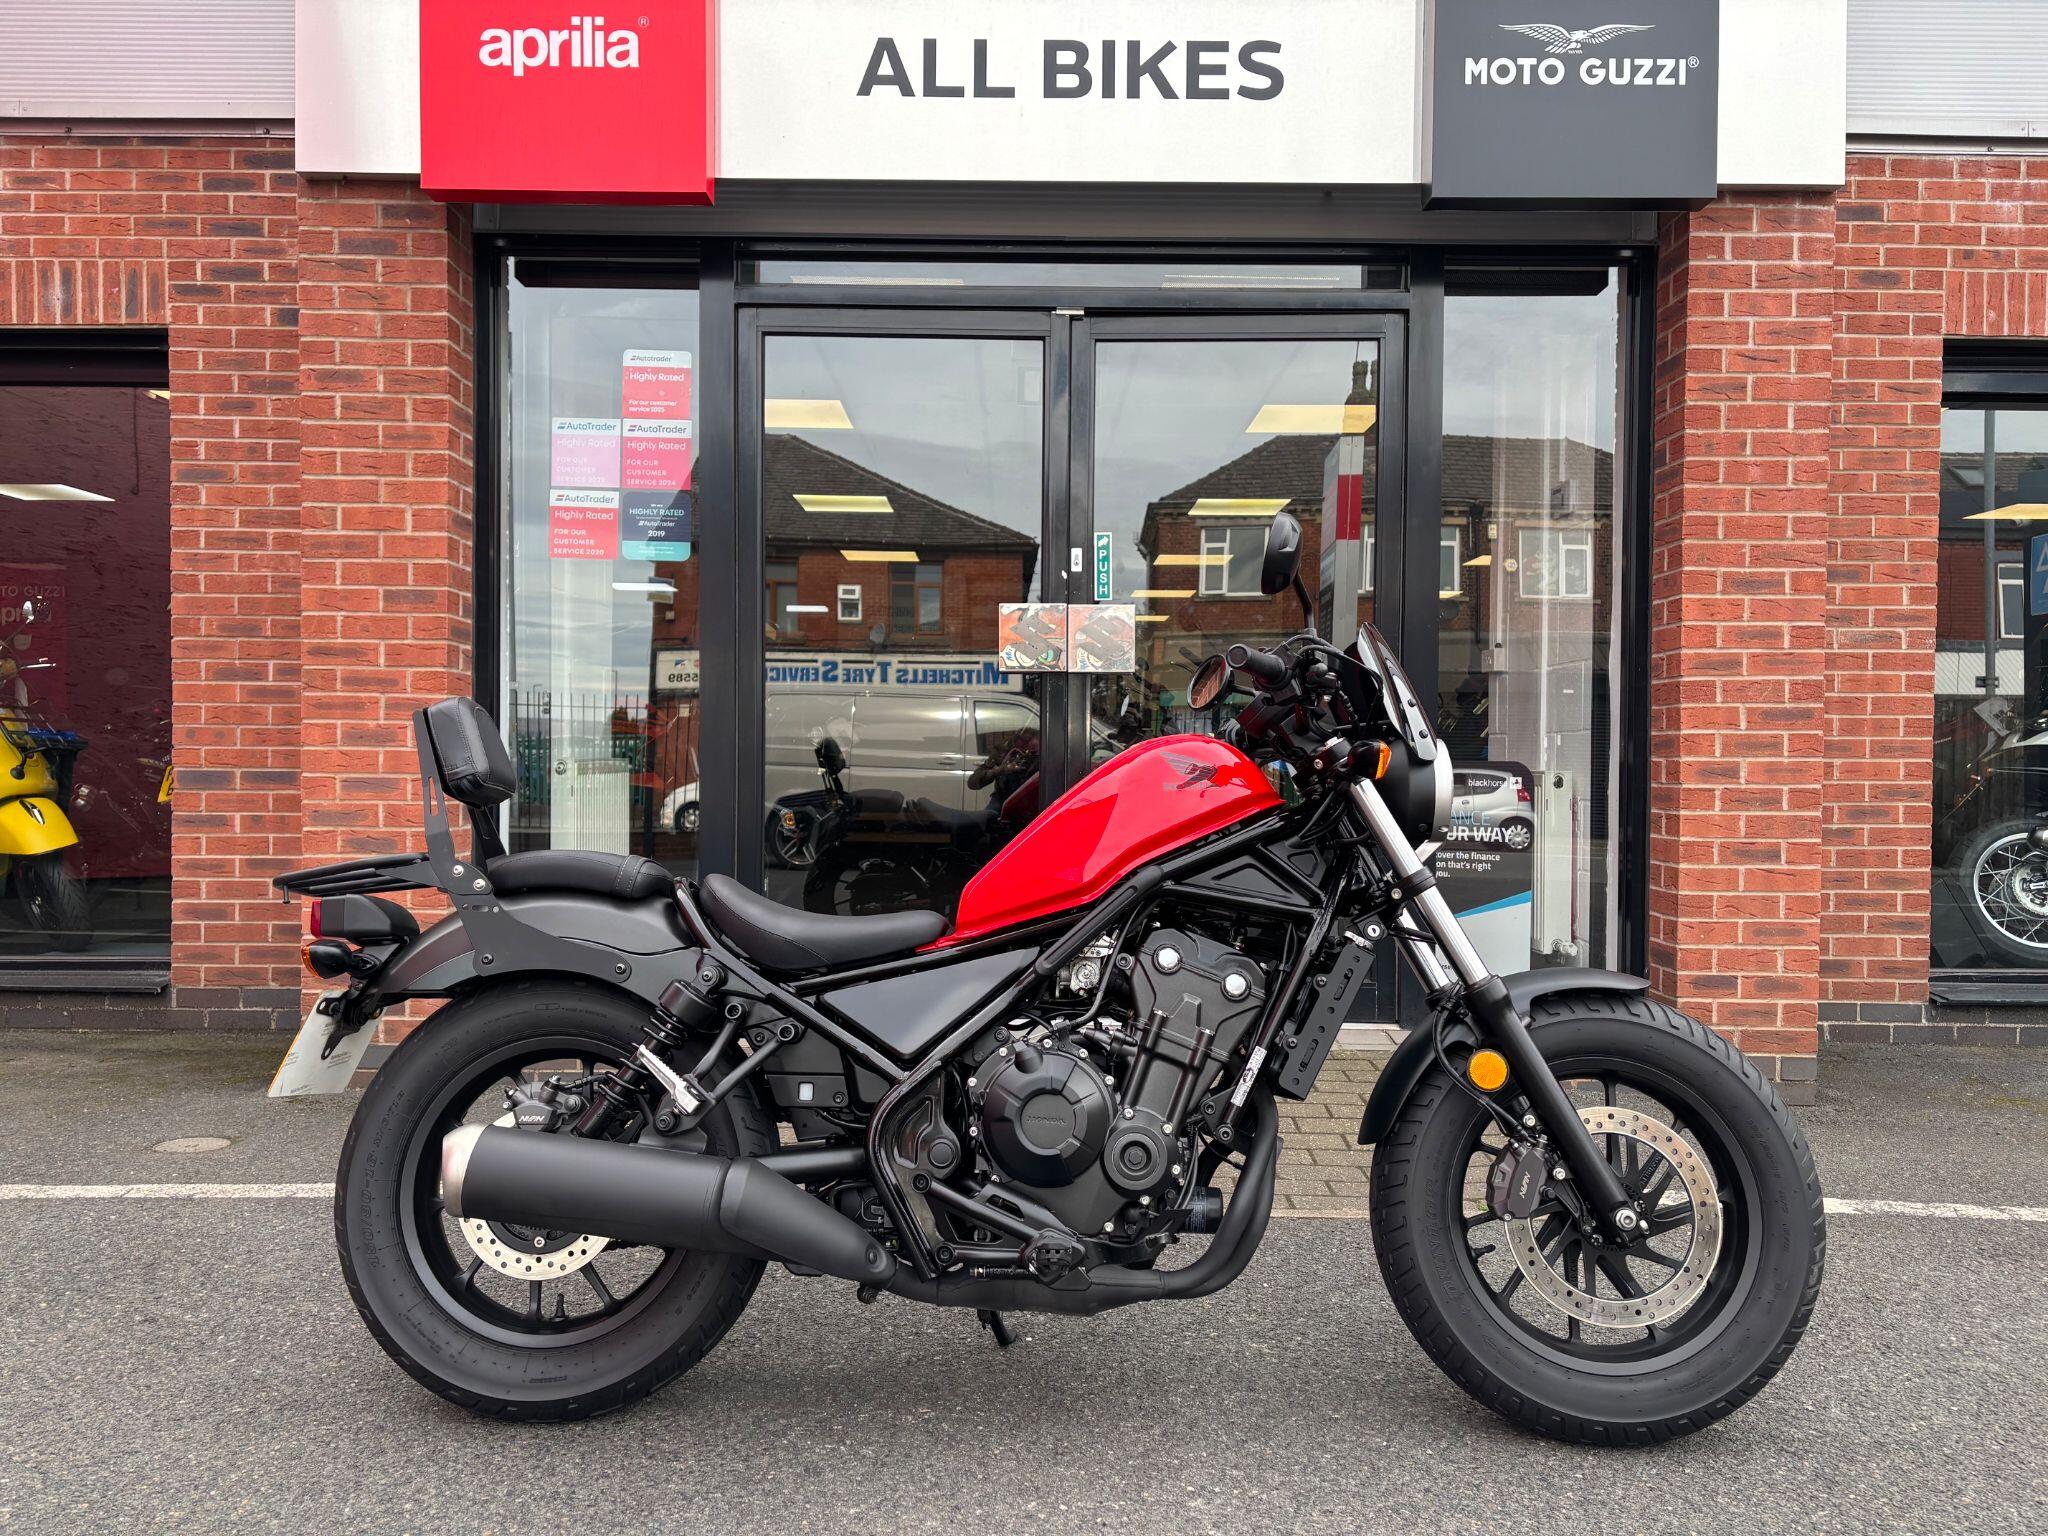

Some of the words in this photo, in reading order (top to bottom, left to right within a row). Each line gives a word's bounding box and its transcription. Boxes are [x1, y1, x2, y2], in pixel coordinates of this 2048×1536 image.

[478, 16, 640, 77] aprilia
[856, 37, 1015, 98] ALL
[1043, 39, 1285, 100] BIKES
[1464, 57, 1566, 86] MOTO
[629, 371, 657, 382] Highly
[659, 373, 685, 382] Rated
[566, 421, 617, 431] AutoTrader
[637, 424, 688, 434] AutoTrader
[627, 440, 656, 451] Highly
[658, 441, 686, 450] Rated
[564, 494, 615, 504] AutoTrader
[554, 510, 584, 521] Highly
[585, 511, 614, 520] Rated
[629, 508, 658, 516] HIGHLY
[553, 538, 595, 546] CUSTOMER
[1099, 549, 1108, 595] PUSH
[1473, 827, 1510, 843] WAY
[1436, 852, 1454, 861] over
[1456, 852, 1470, 860] the
[1471, 852, 1501, 861] finance
[1447, 861, 1470, 869] that's
[1472, 862, 1492, 871] right
